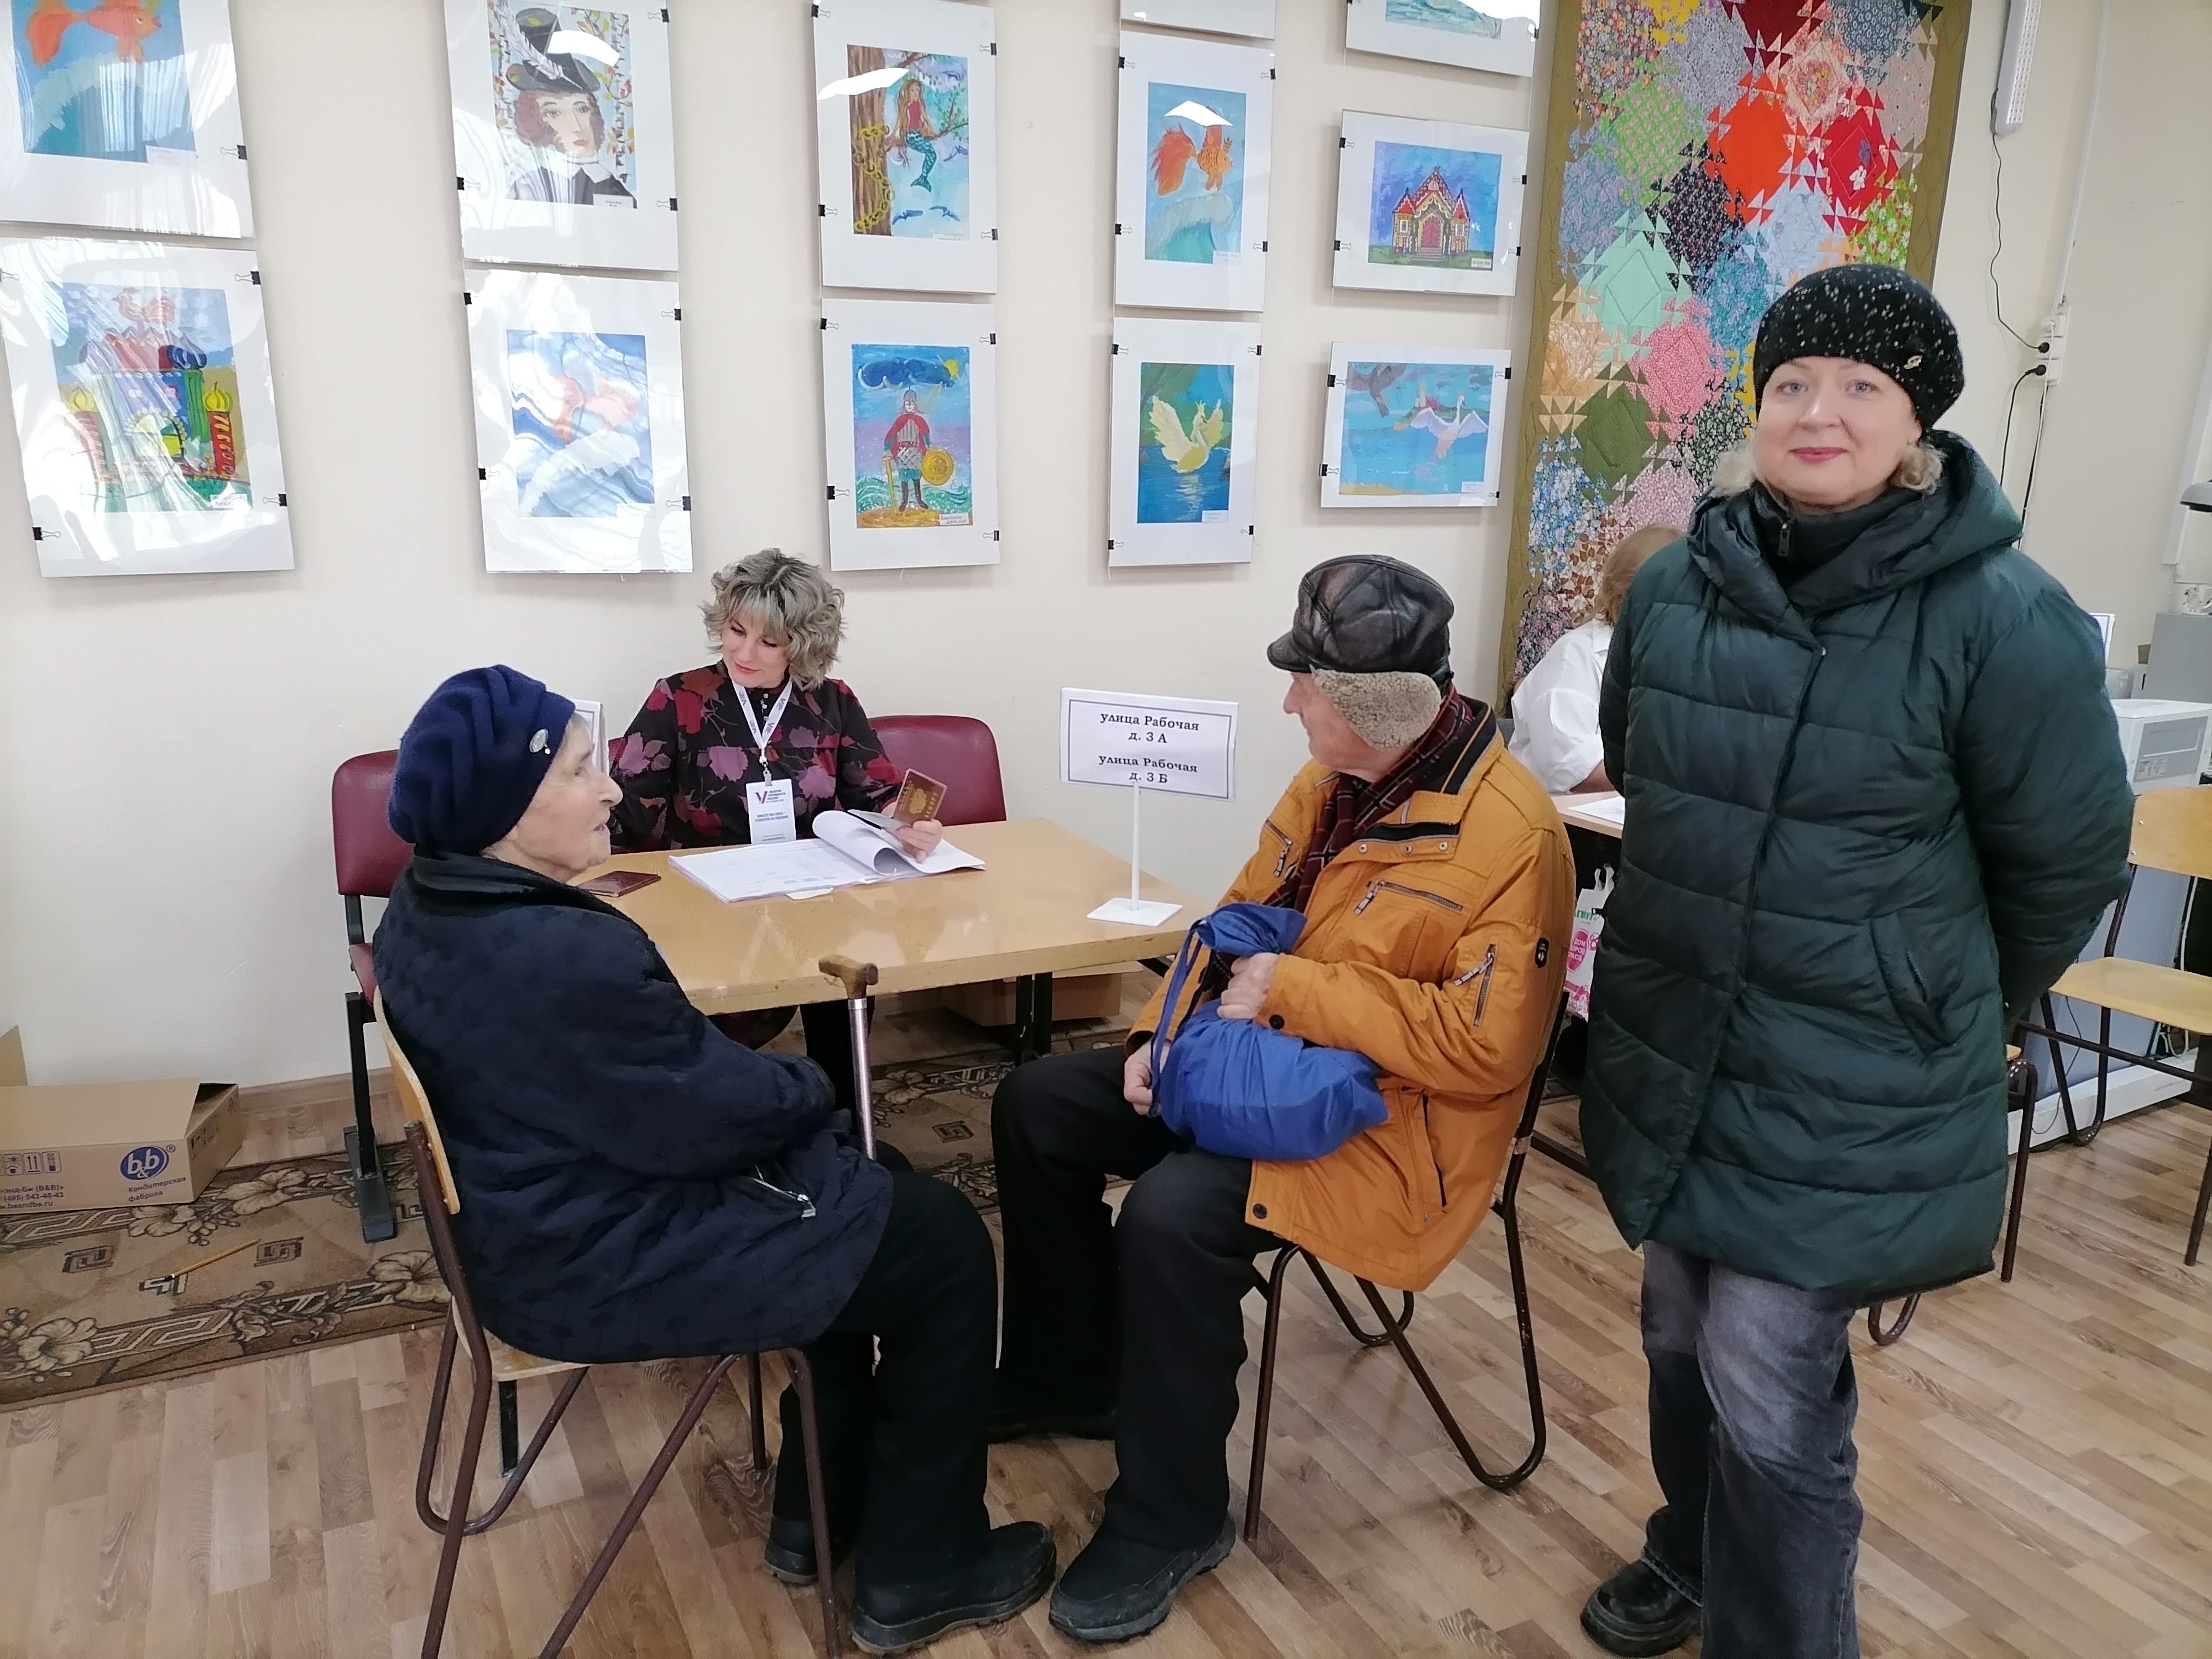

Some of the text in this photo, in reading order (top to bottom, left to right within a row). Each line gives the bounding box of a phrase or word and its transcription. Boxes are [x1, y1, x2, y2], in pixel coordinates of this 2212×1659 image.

[1100, 713, 1199, 731] улица Рабочая
[1128, 732, 1167, 743] д. 3 А
[1098, 755, 1198, 773] улица Рабочая
[1129, 772, 1168, 783] д. 3 Б
[128, 1177, 186, 1192] Кондитерская
[128, 1191, 163, 1202] фабрика
